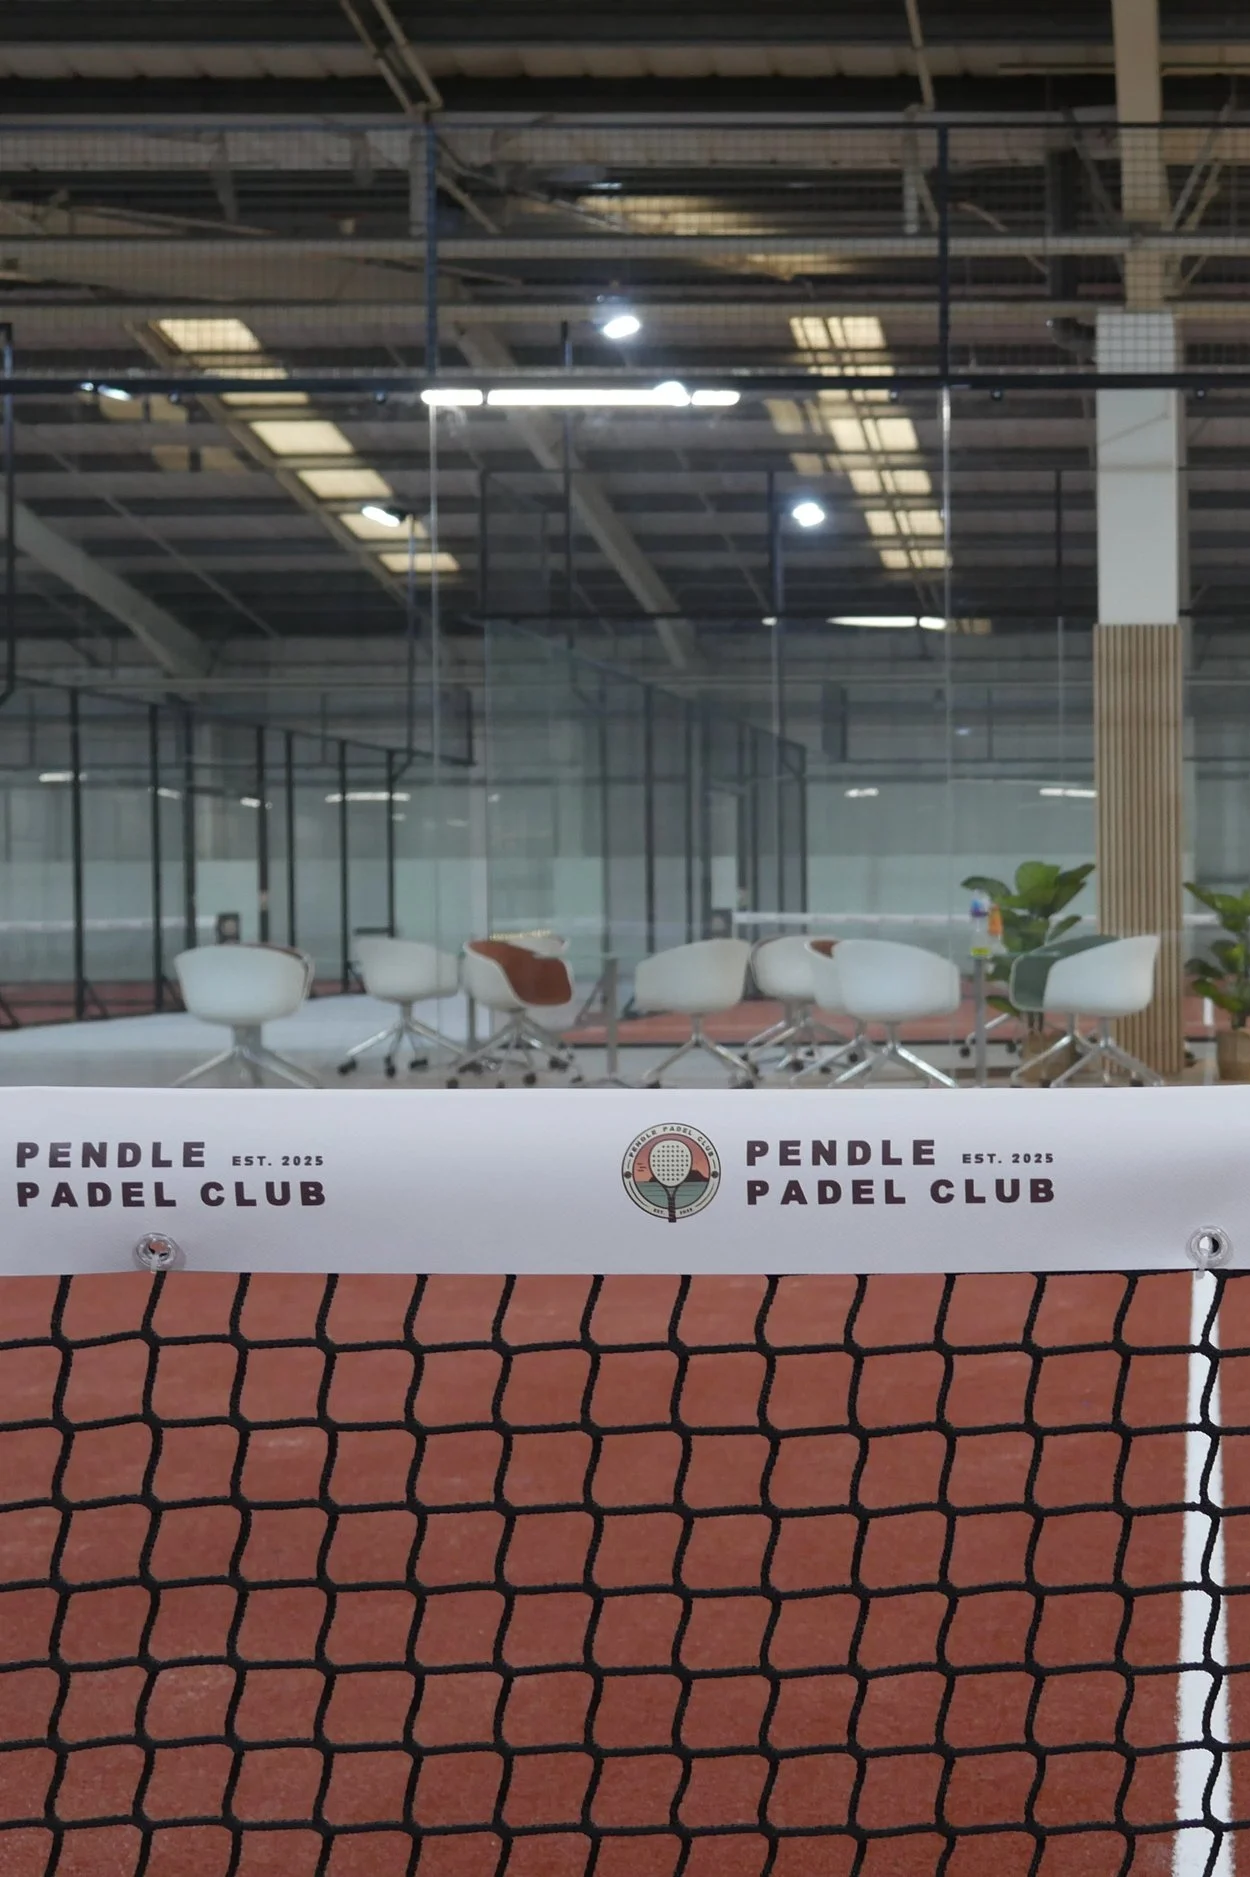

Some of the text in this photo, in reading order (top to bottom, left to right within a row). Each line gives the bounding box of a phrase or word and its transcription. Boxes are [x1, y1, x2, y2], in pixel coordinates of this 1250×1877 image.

[16, 1141, 324, 1169] PENDLE EST. 2025
[628, 1126, 715, 1158] PENDLE PADEL CLUB
[746, 1139, 1054, 1167] PENDLE EST. 2025
[16, 1181, 326, 1208] PADEL CLUB
[746, 1178, 1055, 1206] PADEL CLUB
